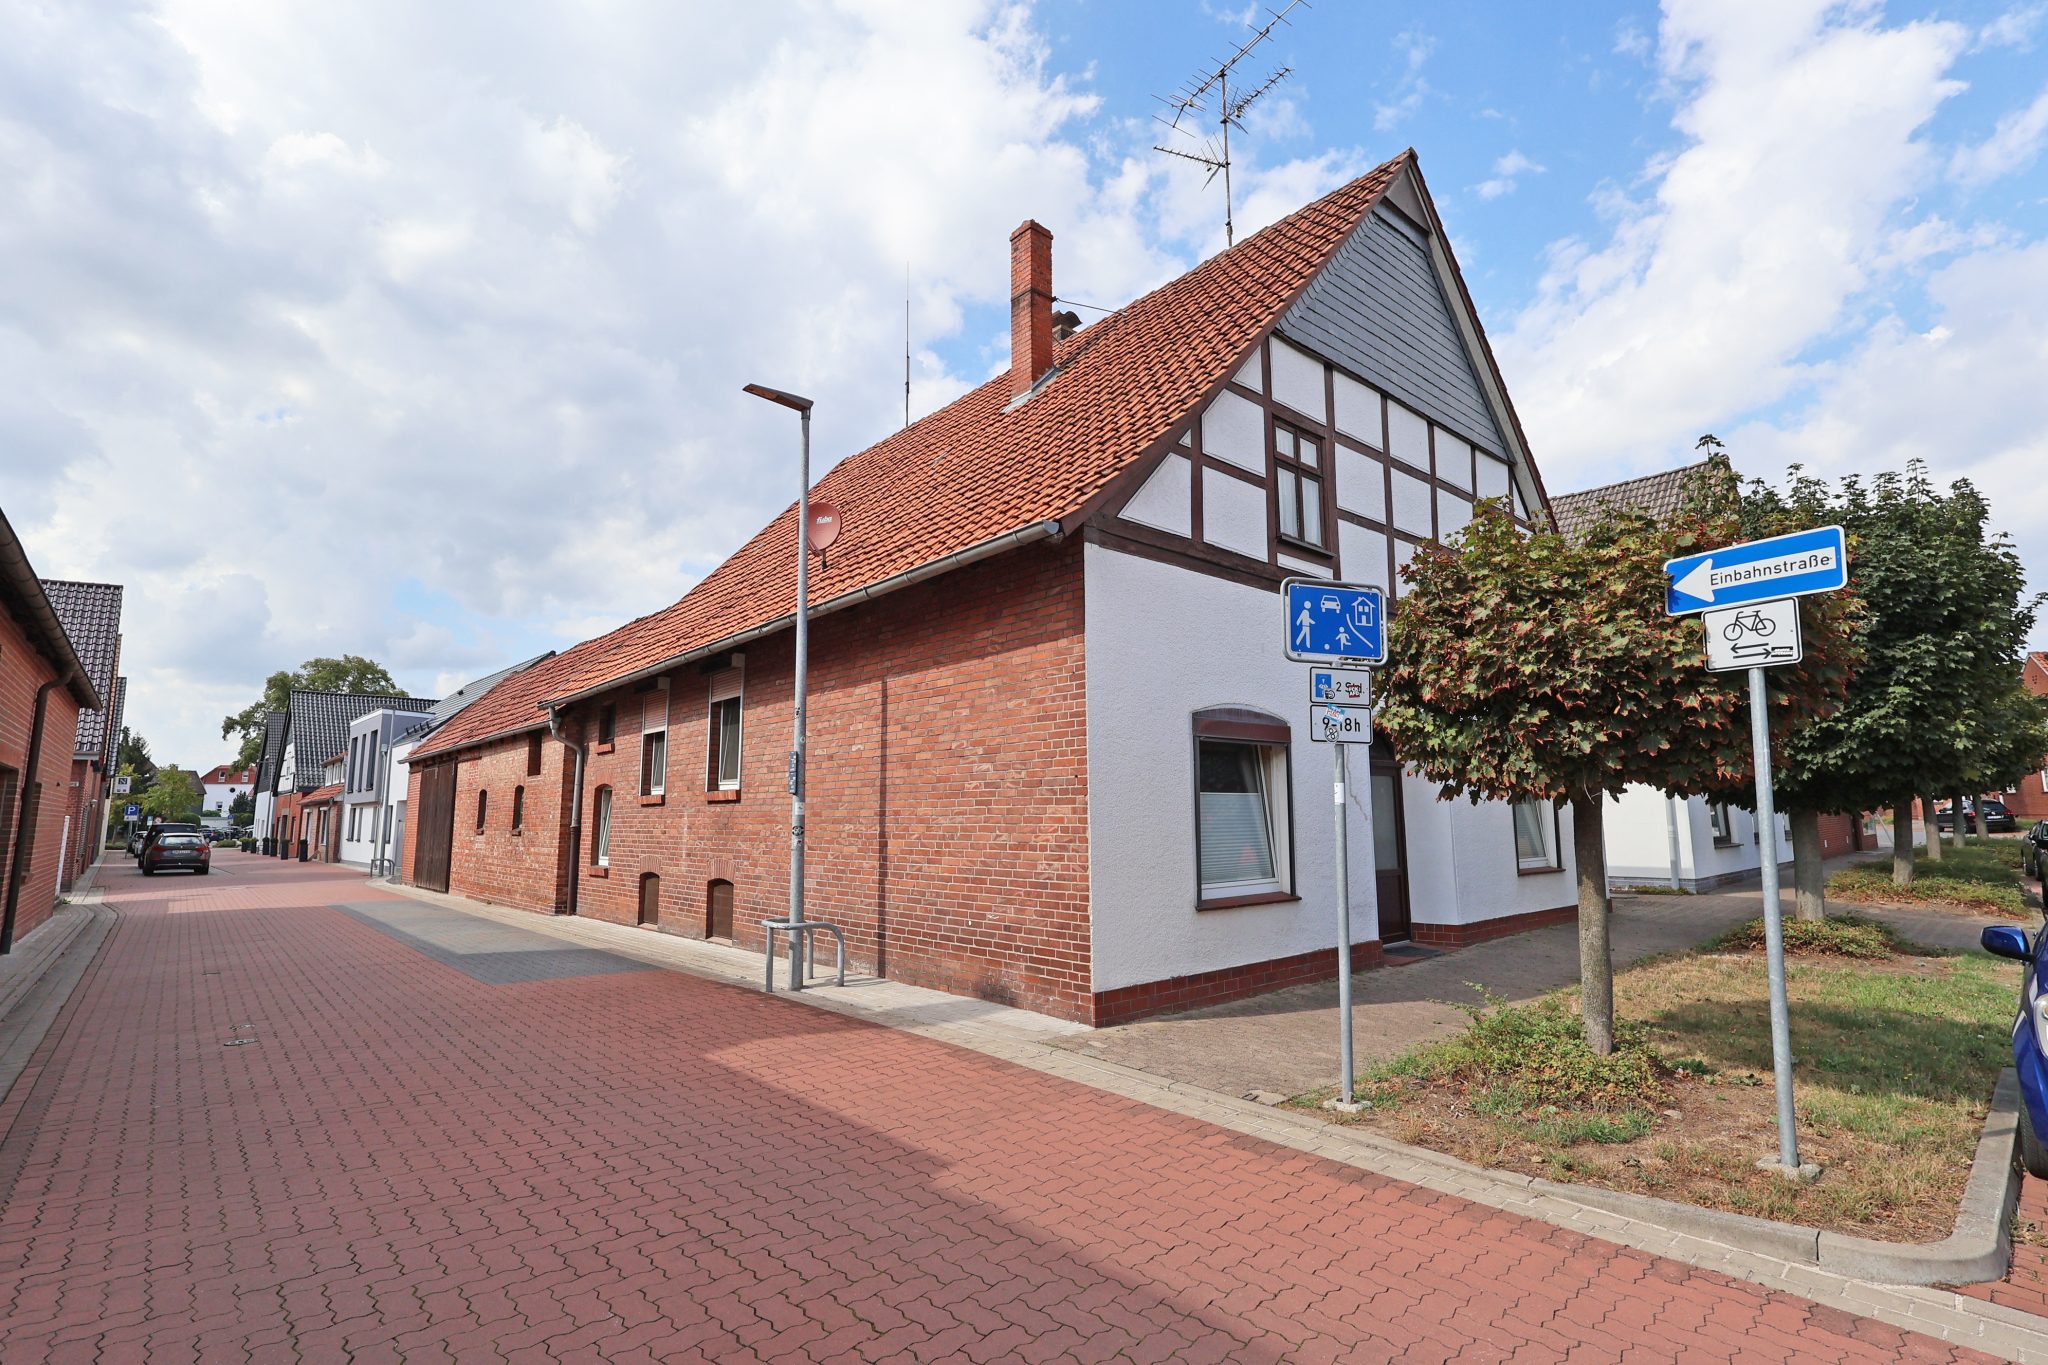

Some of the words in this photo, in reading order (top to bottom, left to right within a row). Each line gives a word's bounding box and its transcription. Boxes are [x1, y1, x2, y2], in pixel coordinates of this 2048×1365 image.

[1710, 554, 1830, 586] Einbahnstraße
[1336, 681, 1341, 692] 2
[127, 806, 136, 814] P
